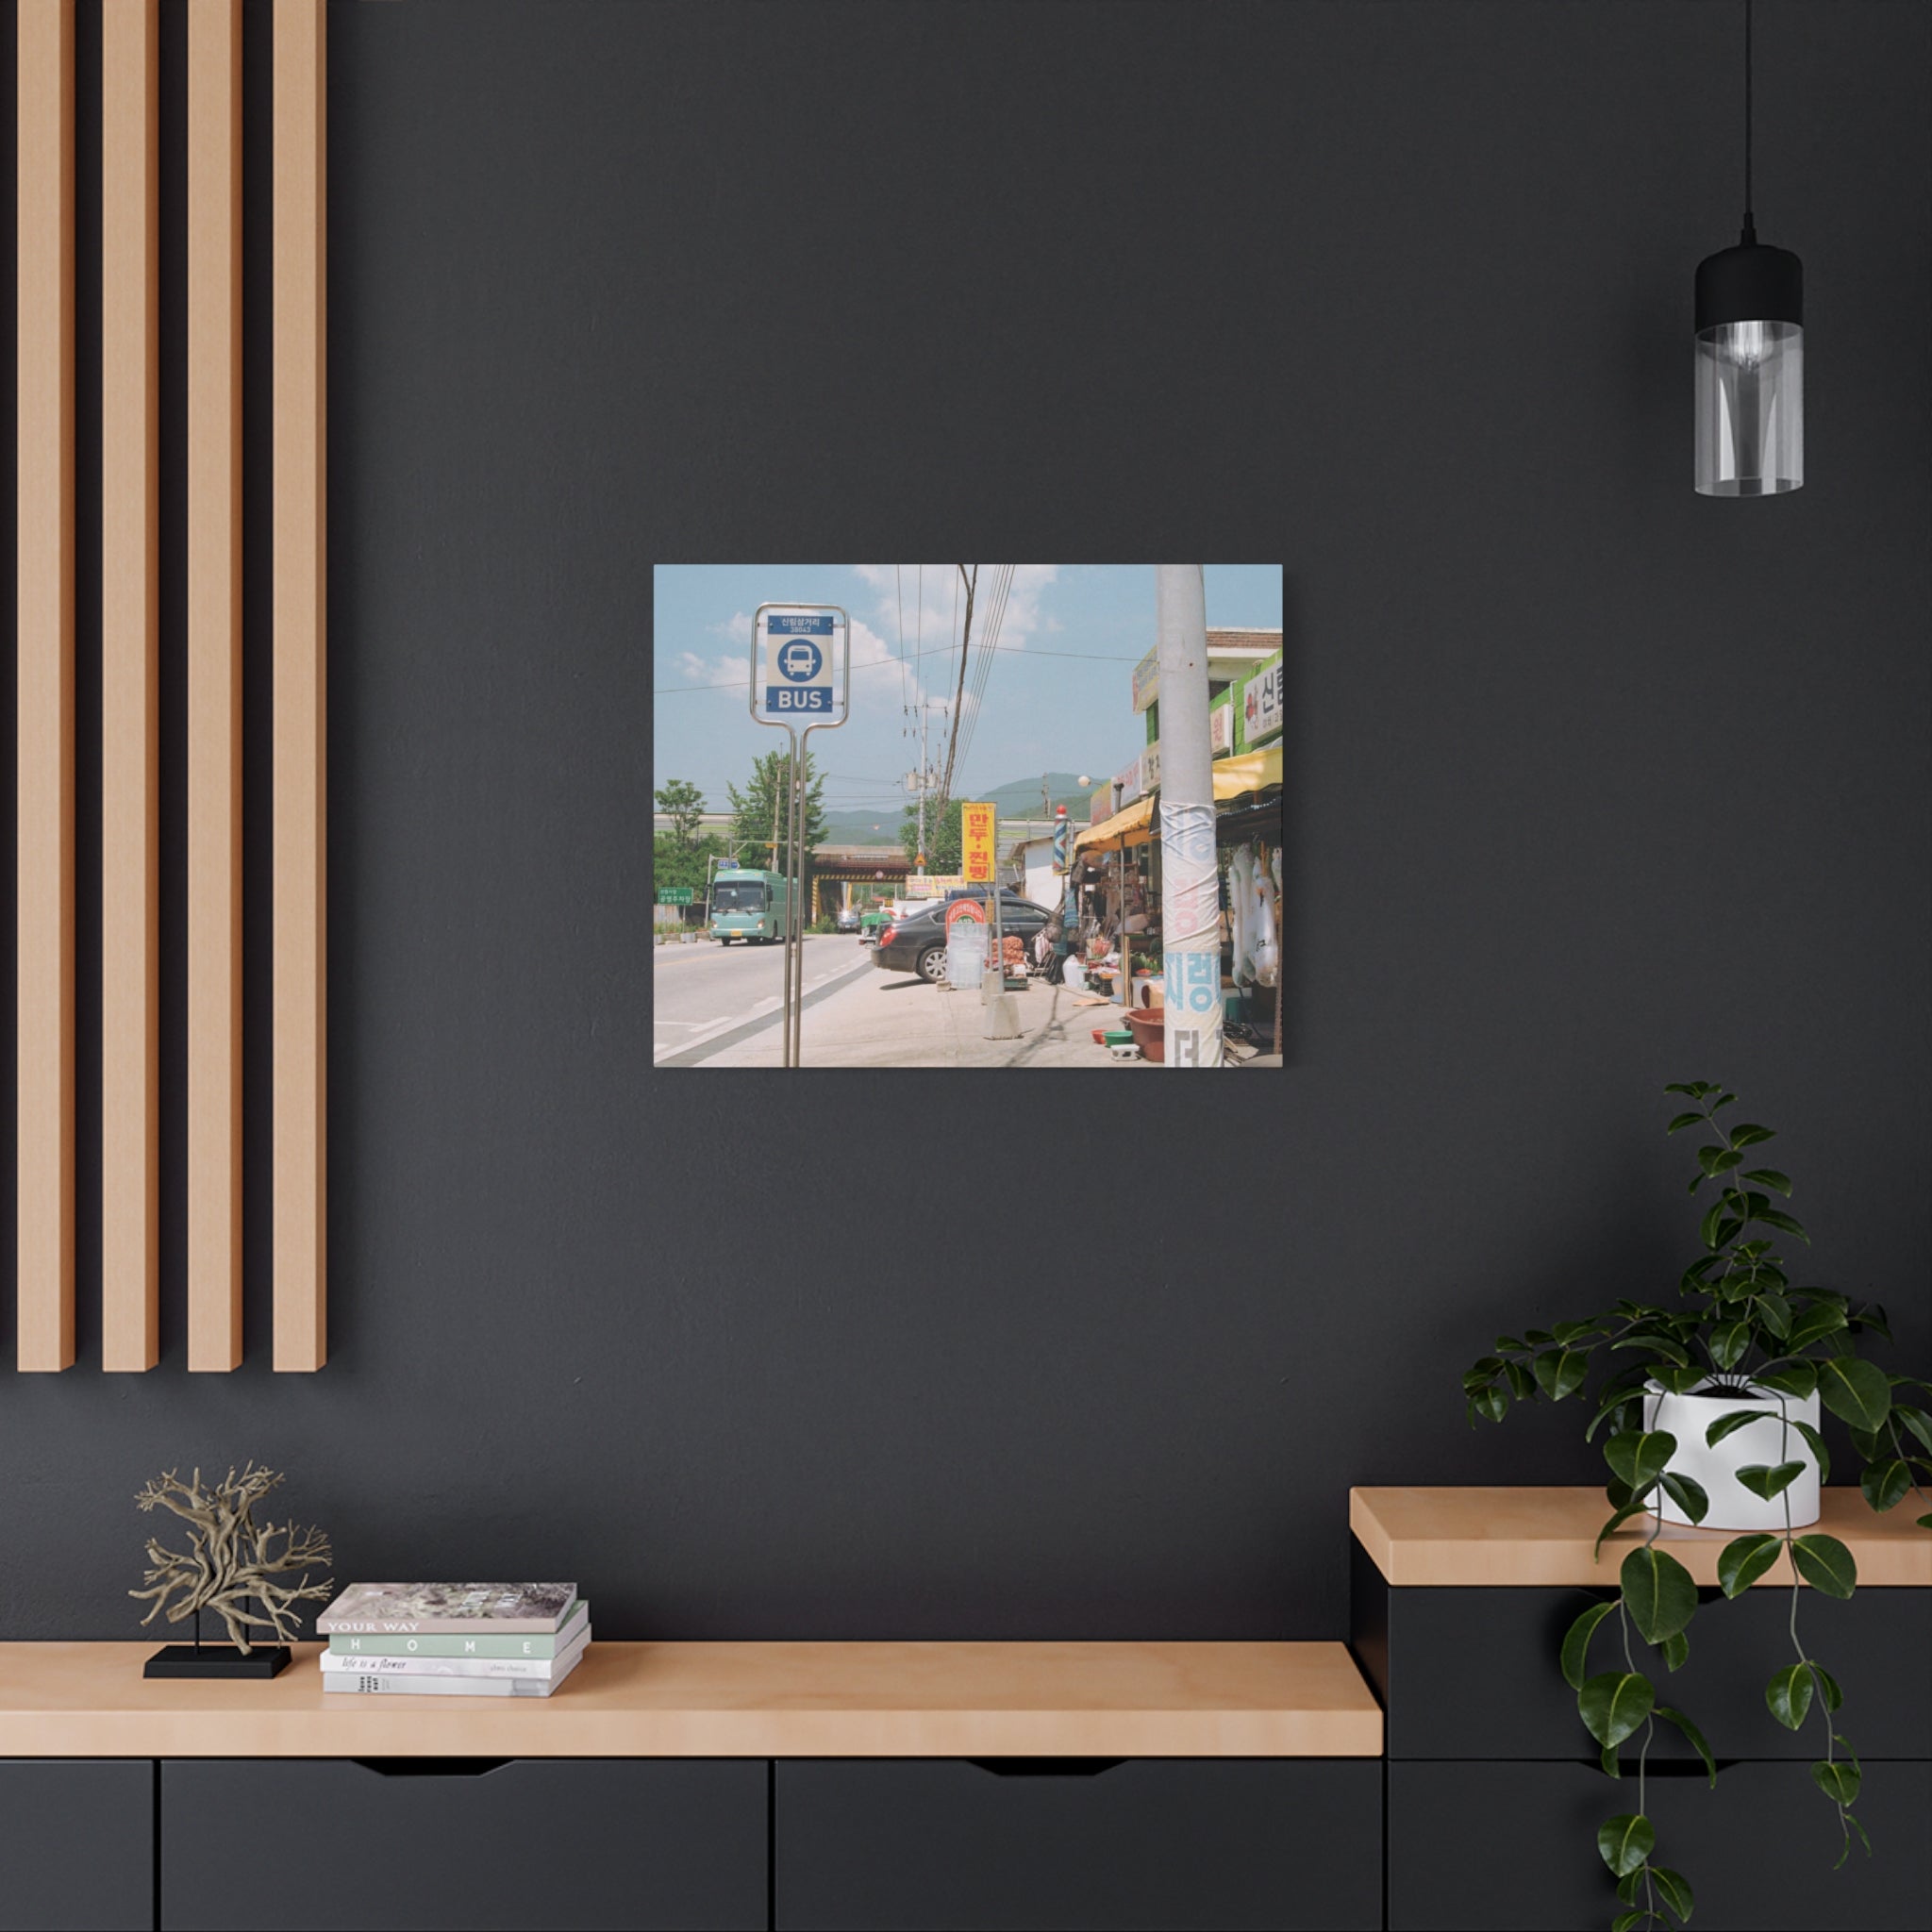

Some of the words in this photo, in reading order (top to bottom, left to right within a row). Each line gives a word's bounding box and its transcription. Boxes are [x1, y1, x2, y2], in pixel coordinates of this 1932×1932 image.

[782, 618, 820, 627] 신림삼거리
[778, 691, 823, 709] BUS
[328, 1622, 377, 1632] YOUR
[383, 1622, 420, 1632] WAY
[351, 1638, 531, 1654] HOME
[341, 1657, 358, 1671] life
[378, 1658, 407, 1673] flower
